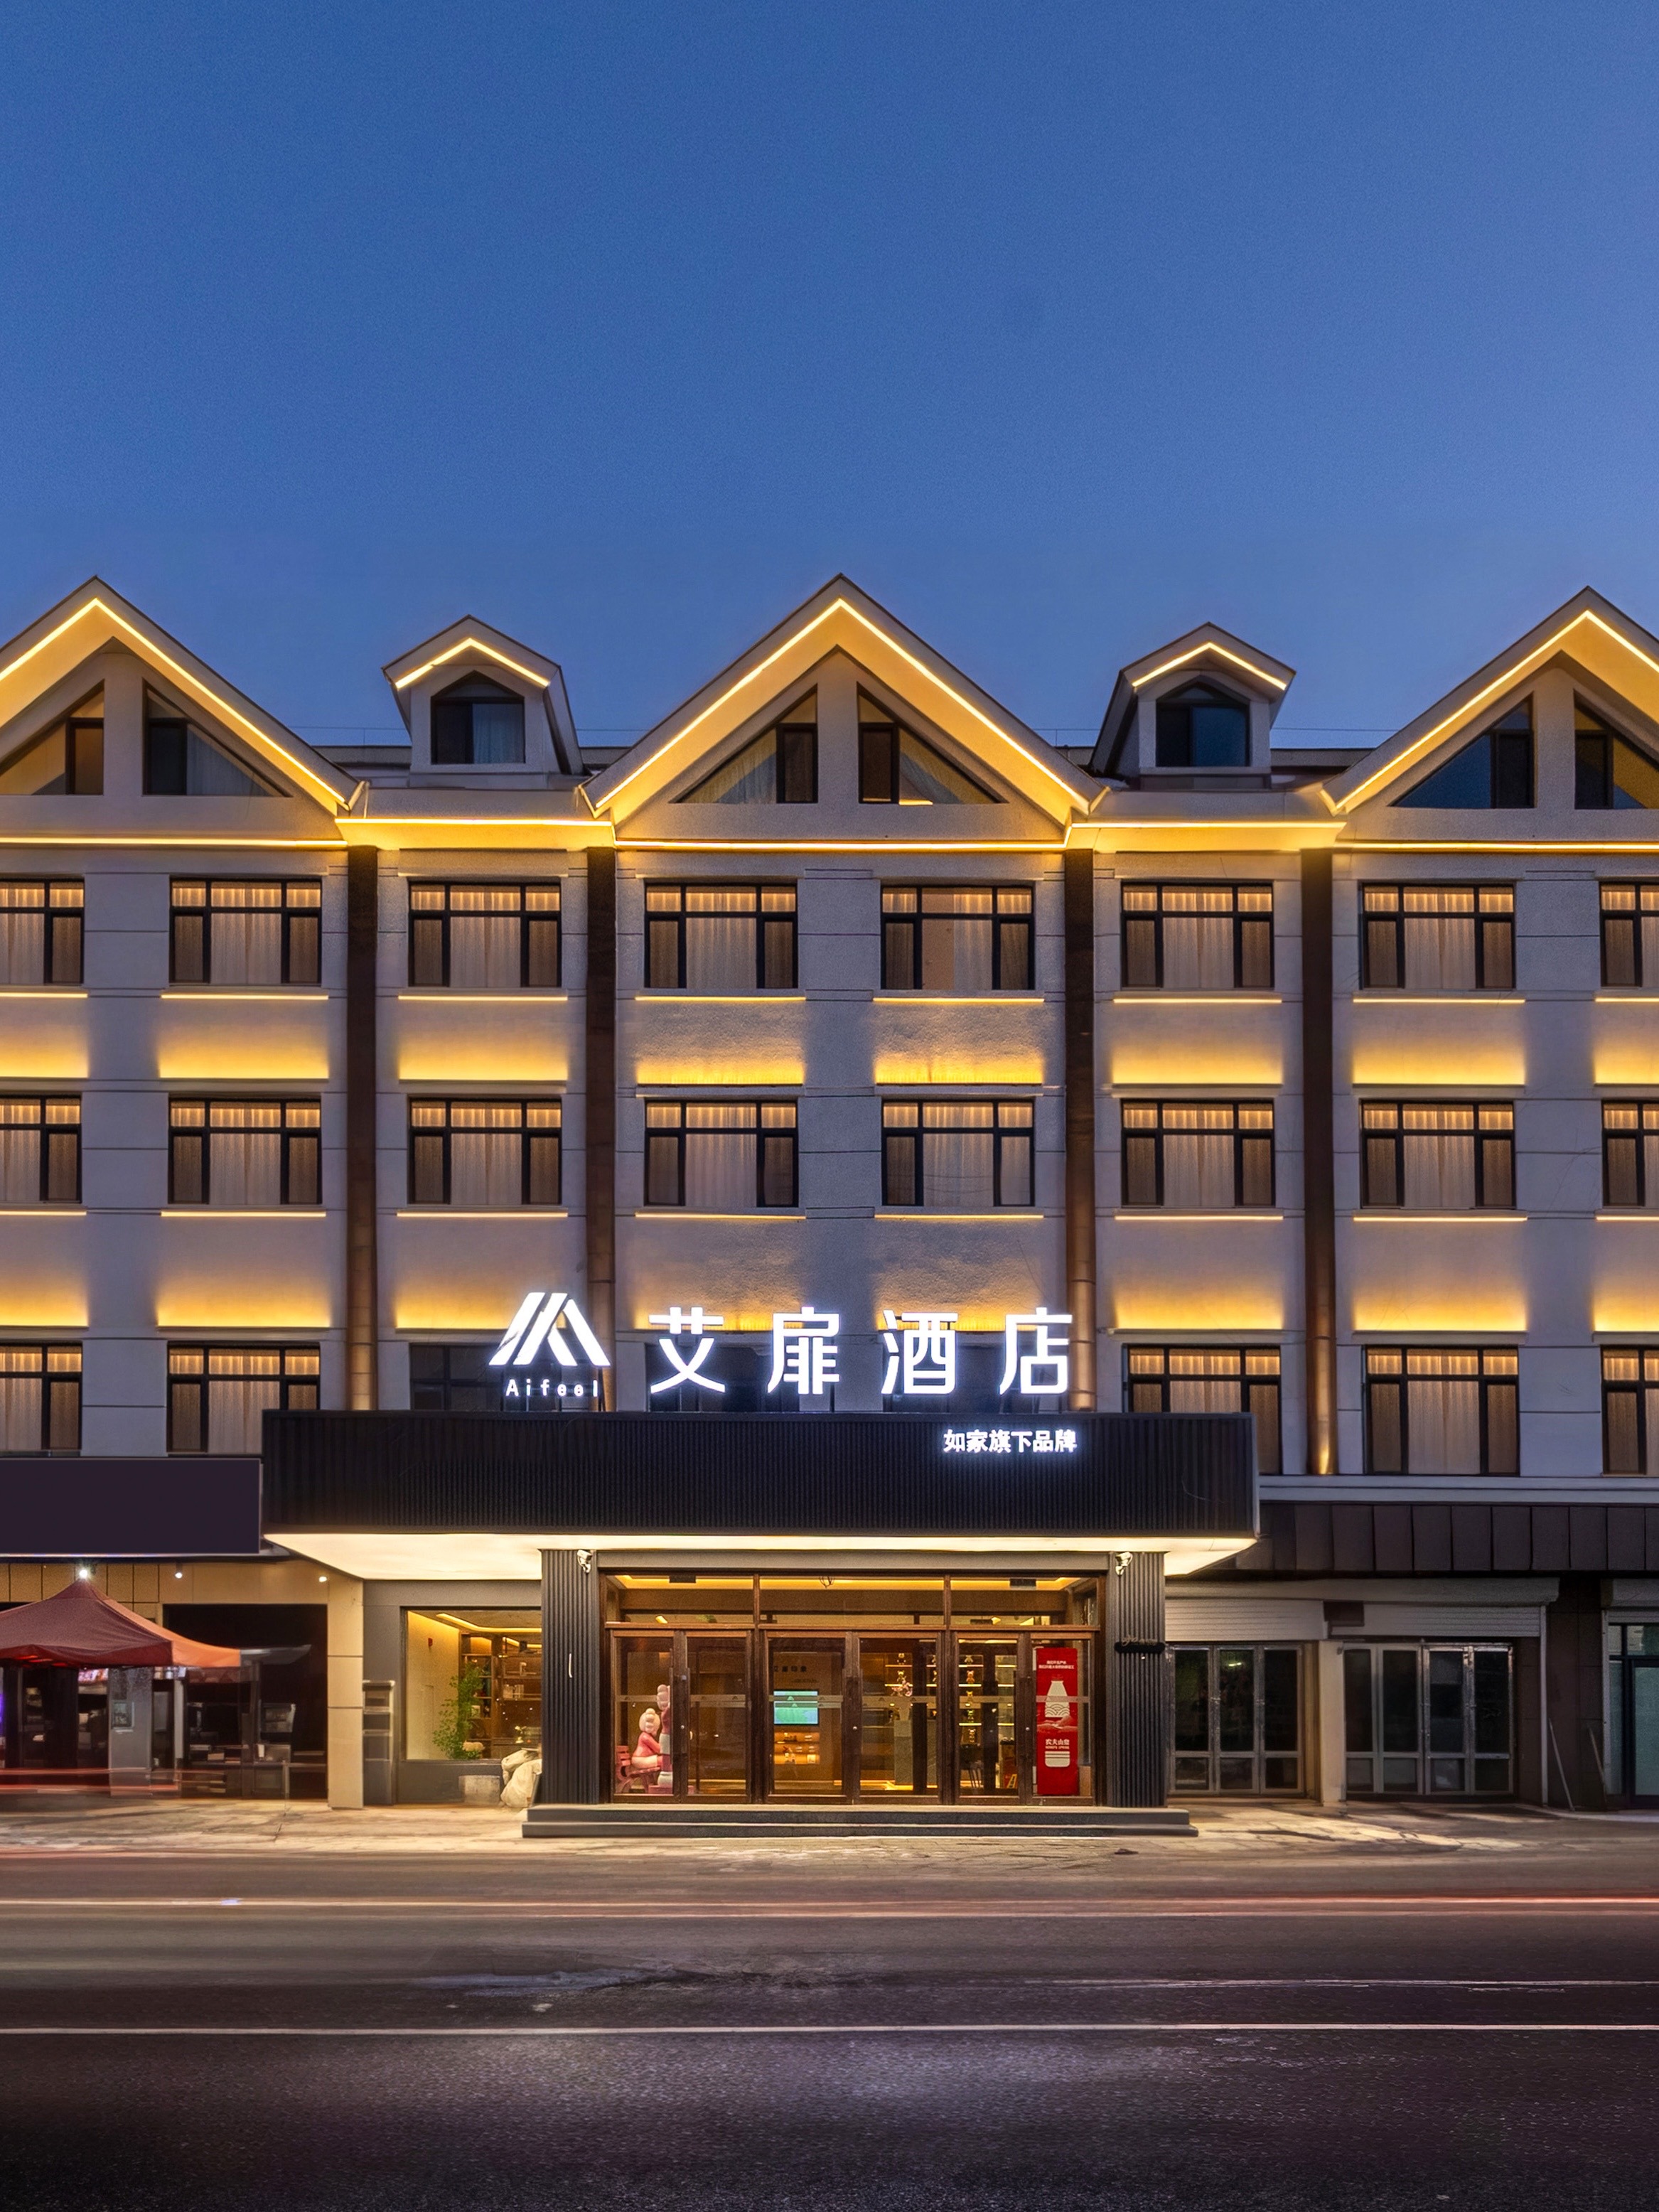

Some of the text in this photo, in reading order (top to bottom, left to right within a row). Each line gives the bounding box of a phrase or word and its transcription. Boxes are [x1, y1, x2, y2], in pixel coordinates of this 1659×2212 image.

[649, 1307, 1072, 1394] 艾扉酒店
[506, 1379, 597, 1397] Aifeel
[944, 1429, 1077, 1453] 如家旗下品牌
